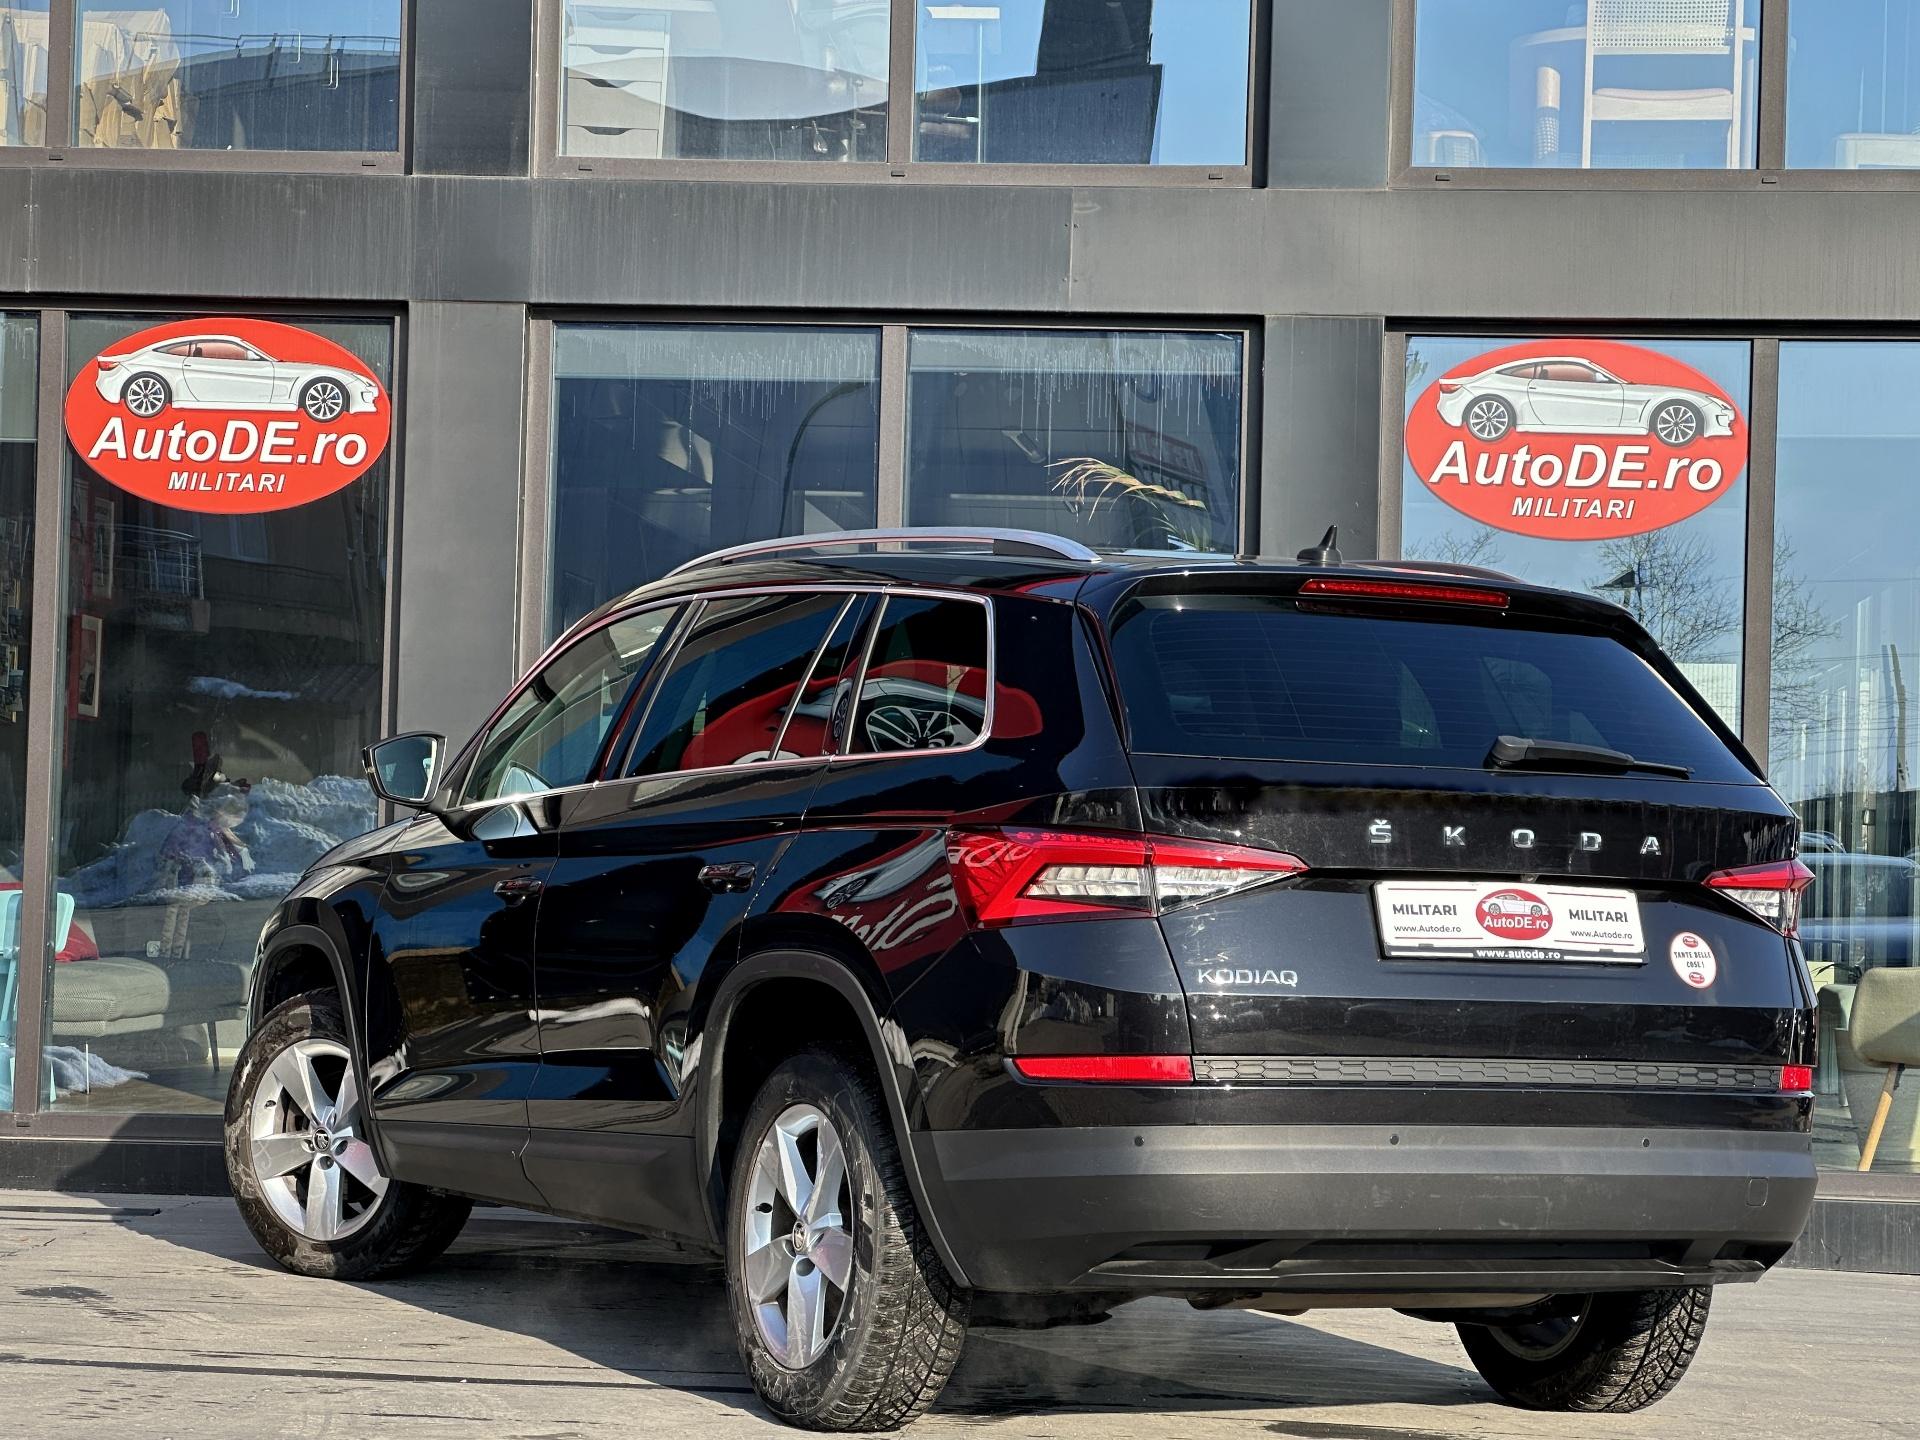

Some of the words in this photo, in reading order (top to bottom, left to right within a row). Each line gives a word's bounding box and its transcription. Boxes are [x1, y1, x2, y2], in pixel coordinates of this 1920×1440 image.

[88, 416, 370, 467] AutoDE.ro
[1429, 440, 1723, 491] AutoDE.ro
[168, 471, 285, 493] MILITARI
[1511, 496, 1635, 519] MILITARI
[1369, 819, 1662, 856] ŠKODA
[1393, 904, 1458, 917] MILITARI
[1569, 908, 1629, 923] MILITARI
[1394, 923, 1462, 934] www.Autode.ro
[1483, 915, 1549, 930] AutoDE.ro
[1571, 929, 1633, 940] www.Autode.ro
[1476, 948, 1561, 960] www.autode.ro
[1198, 968, 1298, 987] KODIAQ
